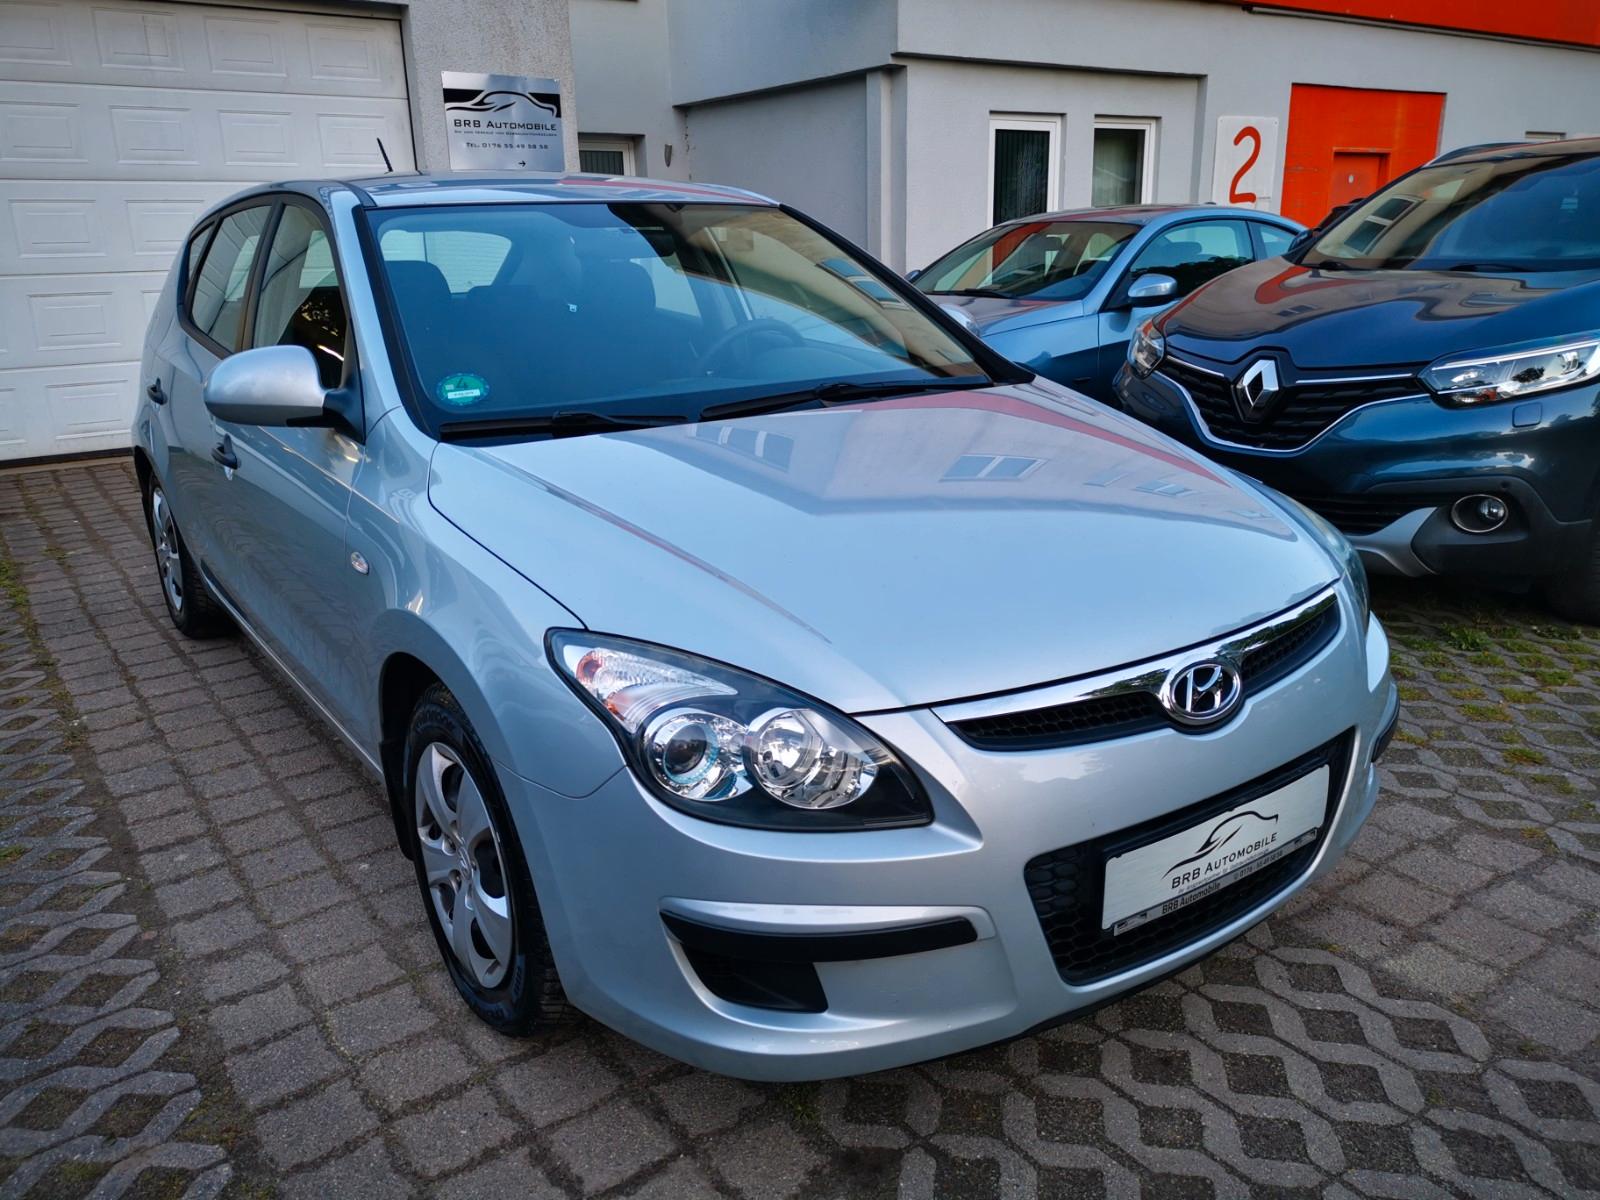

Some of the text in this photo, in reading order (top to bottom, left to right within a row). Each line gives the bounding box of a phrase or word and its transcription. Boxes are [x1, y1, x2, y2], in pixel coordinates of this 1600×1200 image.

[454, 119, 557, 130] BRB AUTOMOBILE
[1229, 126, 1261, 204] 2
[1172, 867, 1201, 888] BRB
[1204, 832, 1278, 875] AUTOMOBILE
[1162, 881, 1221, 914] BRB Automobile
